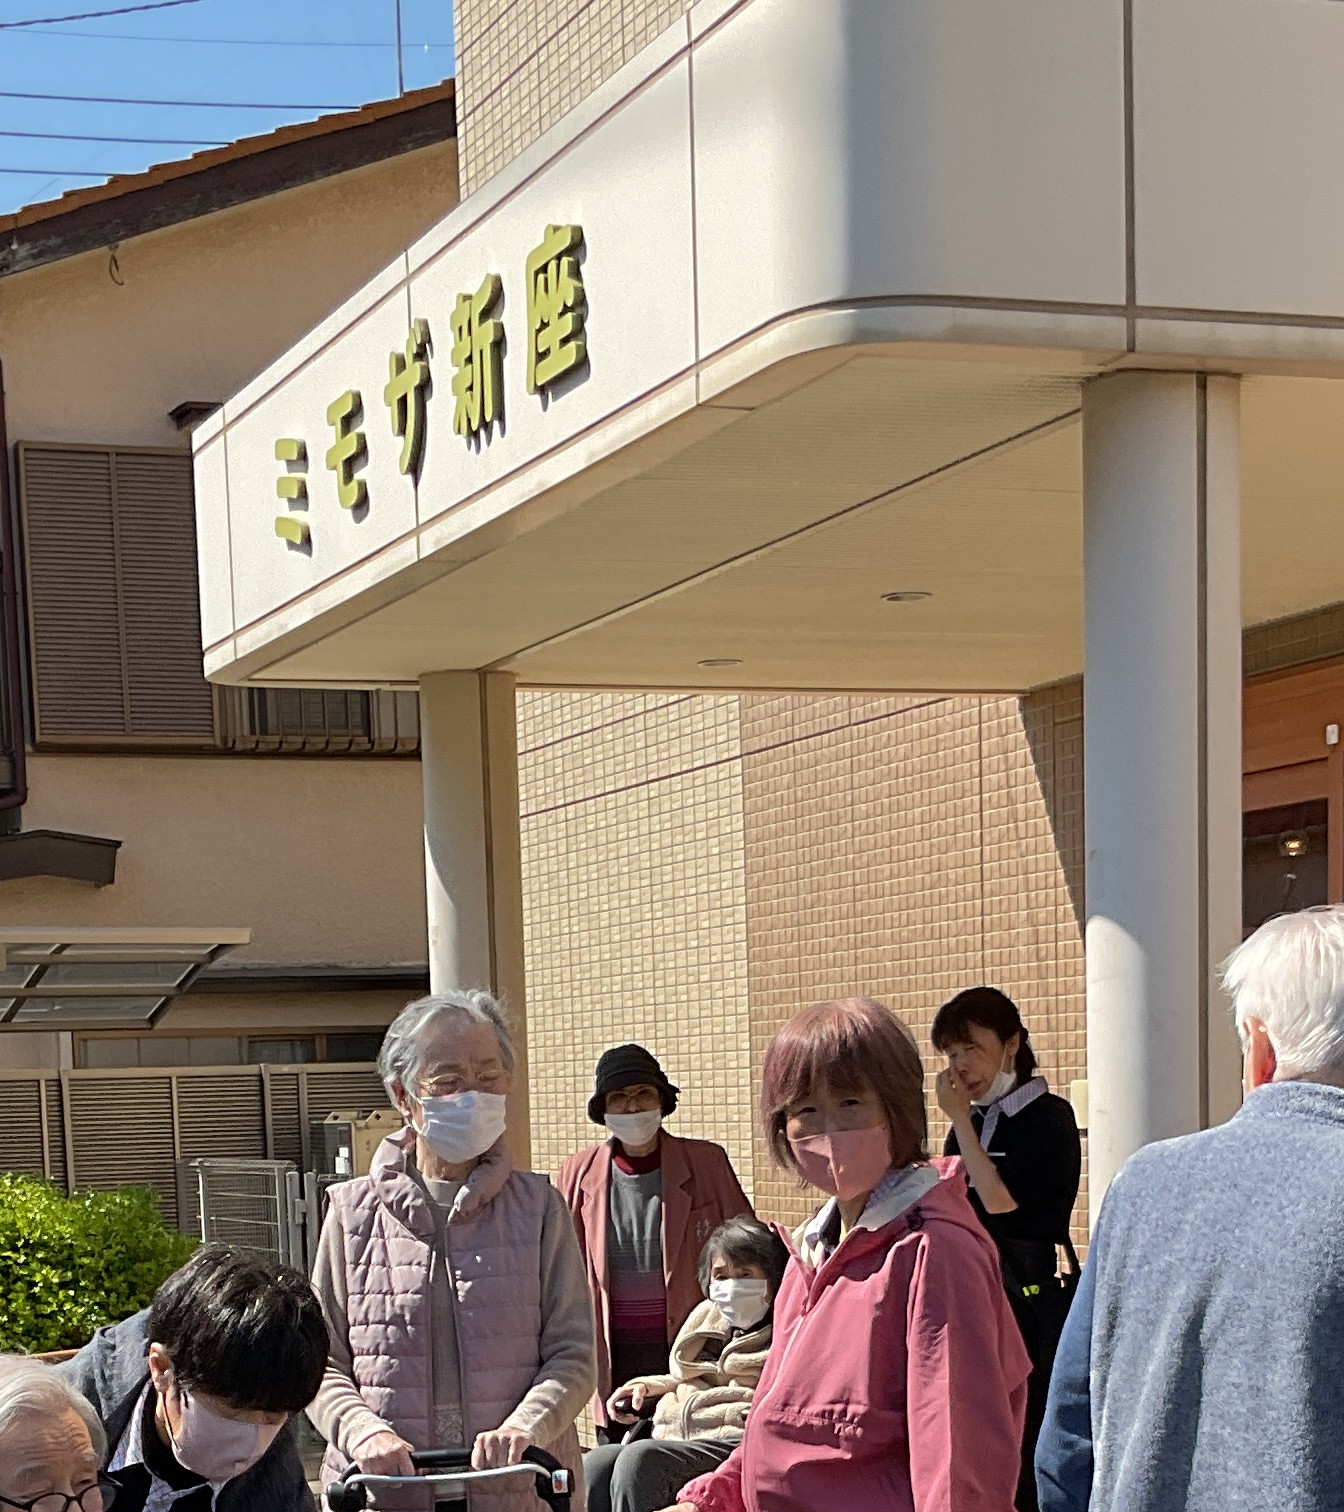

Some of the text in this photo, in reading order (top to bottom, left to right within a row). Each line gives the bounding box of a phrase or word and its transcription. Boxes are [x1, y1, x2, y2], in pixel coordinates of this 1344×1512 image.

[274, 223, 585, 545] ミモザ新座
